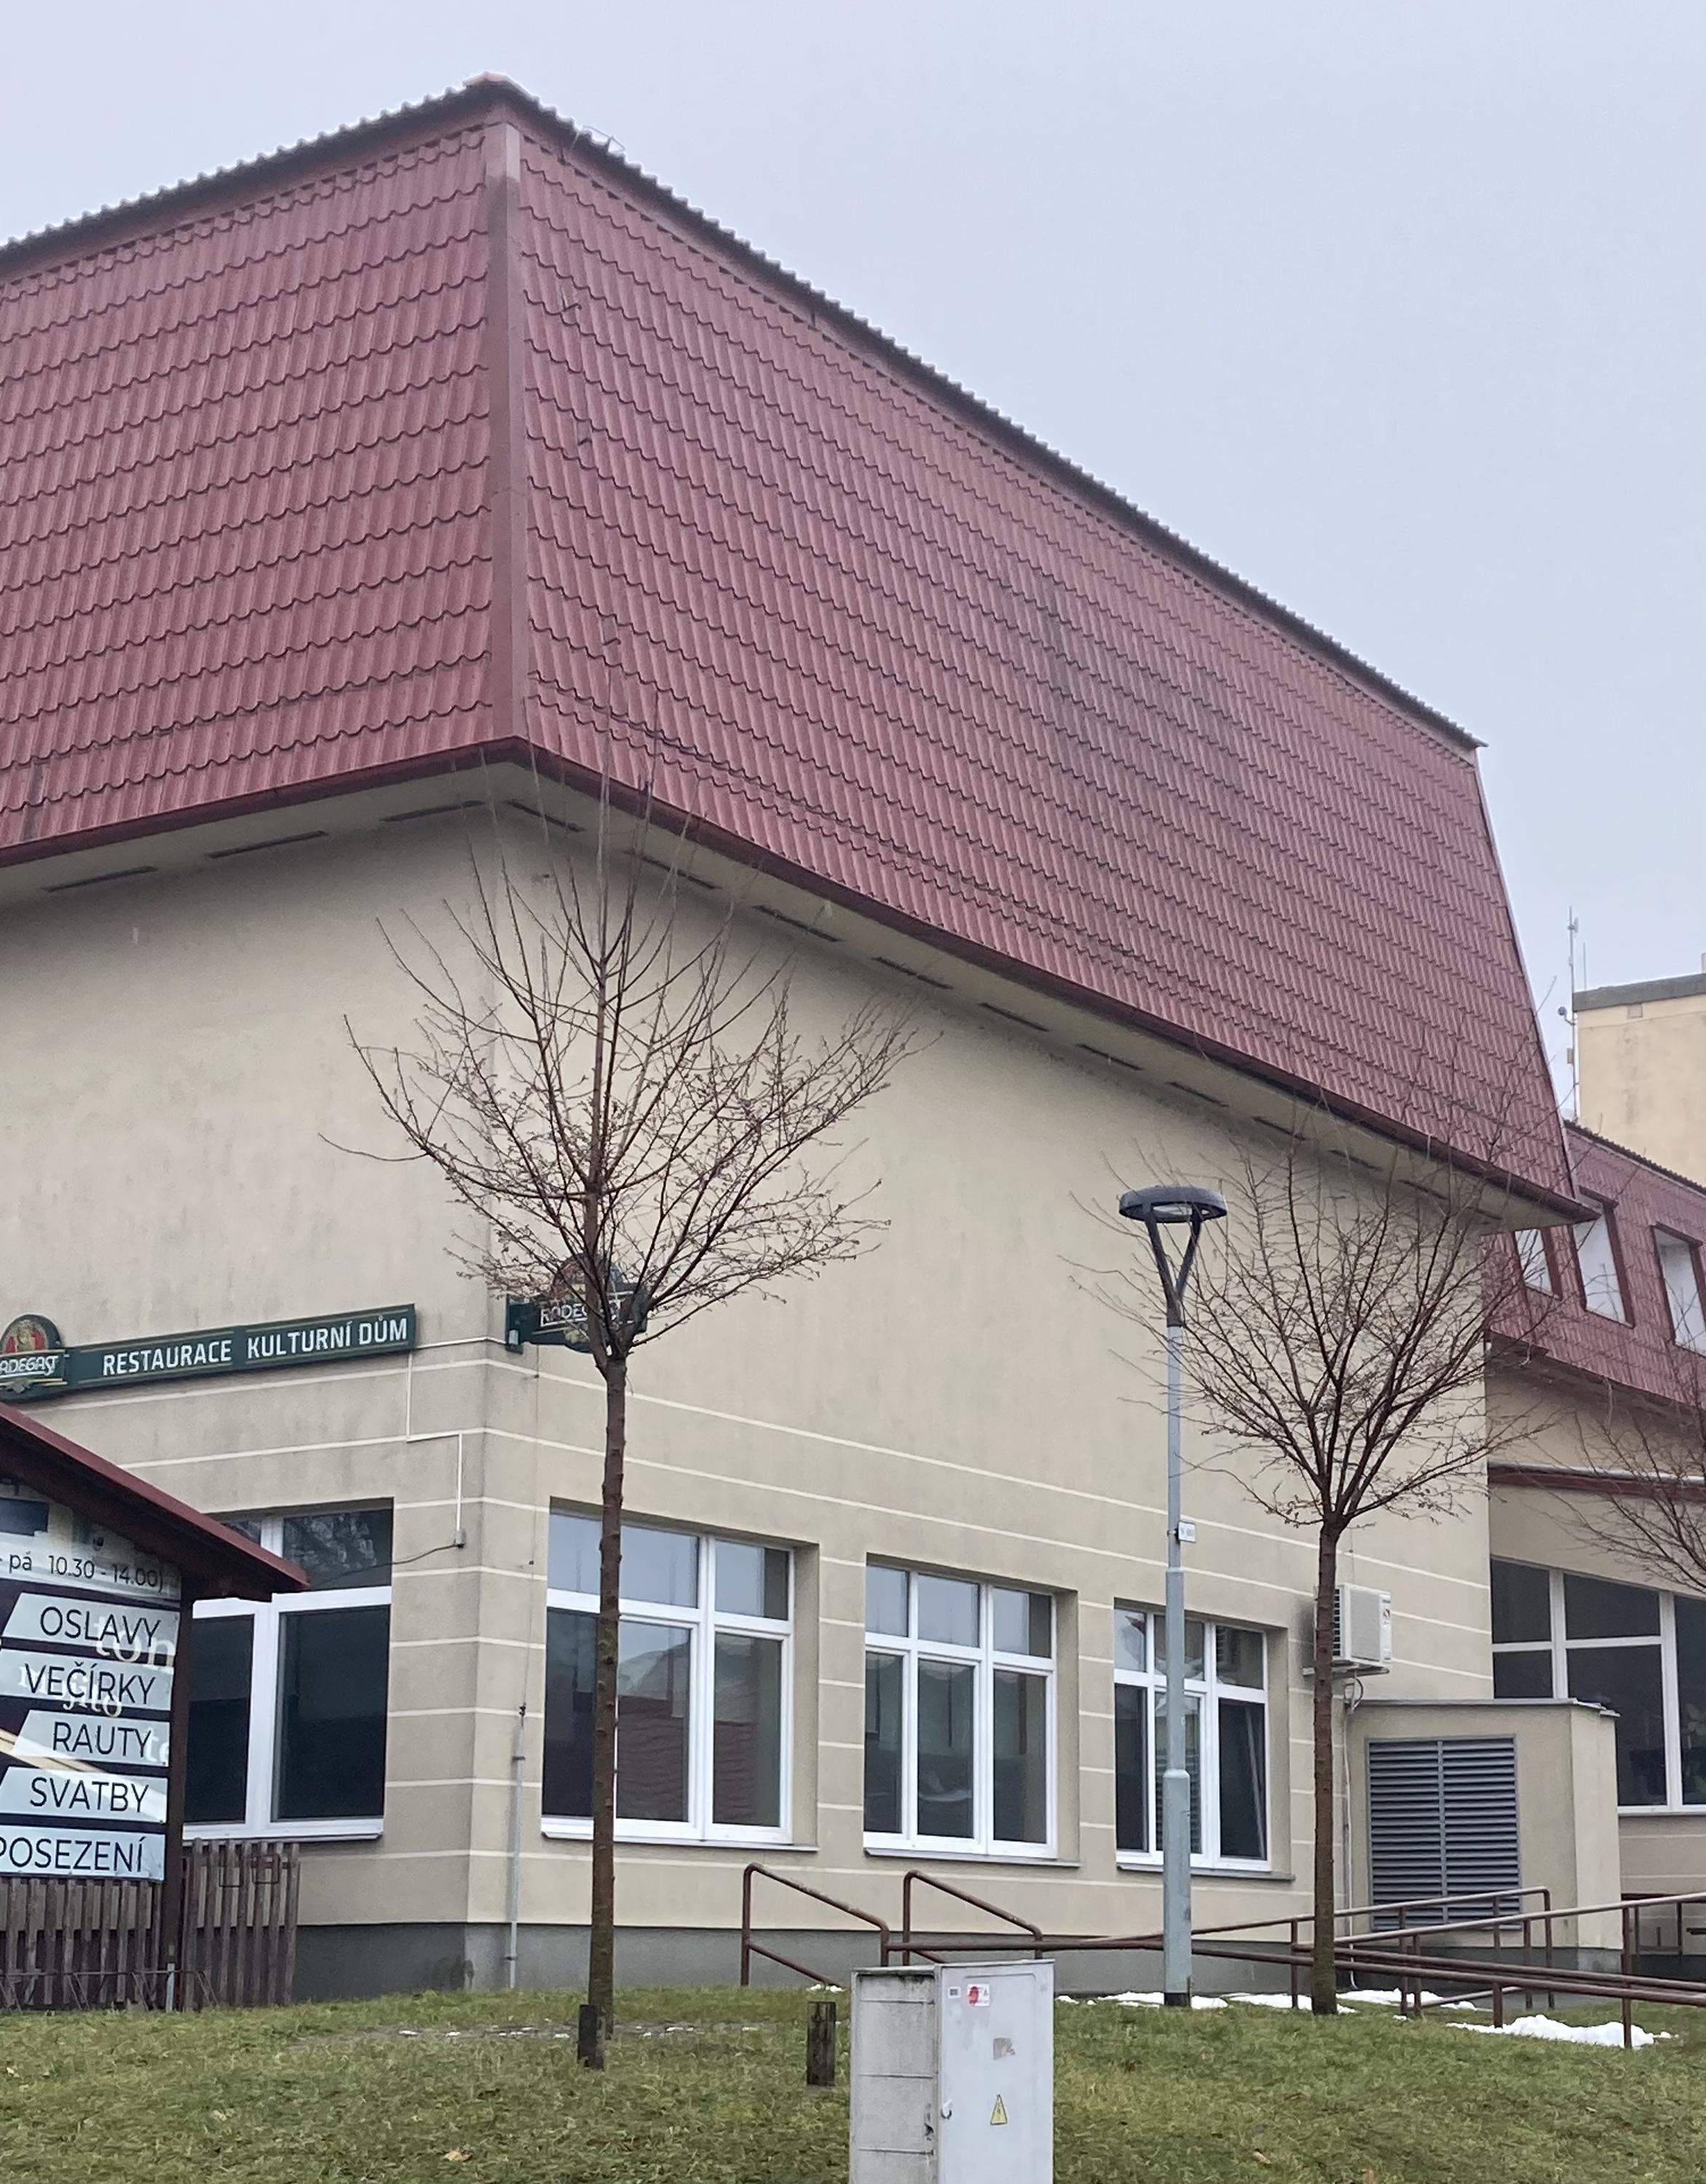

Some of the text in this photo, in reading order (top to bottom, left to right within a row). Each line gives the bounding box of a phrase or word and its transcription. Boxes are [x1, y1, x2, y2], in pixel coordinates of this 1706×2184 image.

[0, 1355, 58, 1377] ADEGAST
[103, 1315, 408, 1377] RESTAURACE KULTURNÍ DŮM
[9, 1551, 33, 1573] pá
[48, 1555, 95, 1579] 10.30
[112, 1564, 164, 1593] 14.00)
[39, 1606, 162, 1647] OSLAVY
[24, 1661, 157, 1705] VEČÍRKY
[52, 1721, 152, 1758] RAUTY
[30, 1776, 149, 1813] SVATBY
